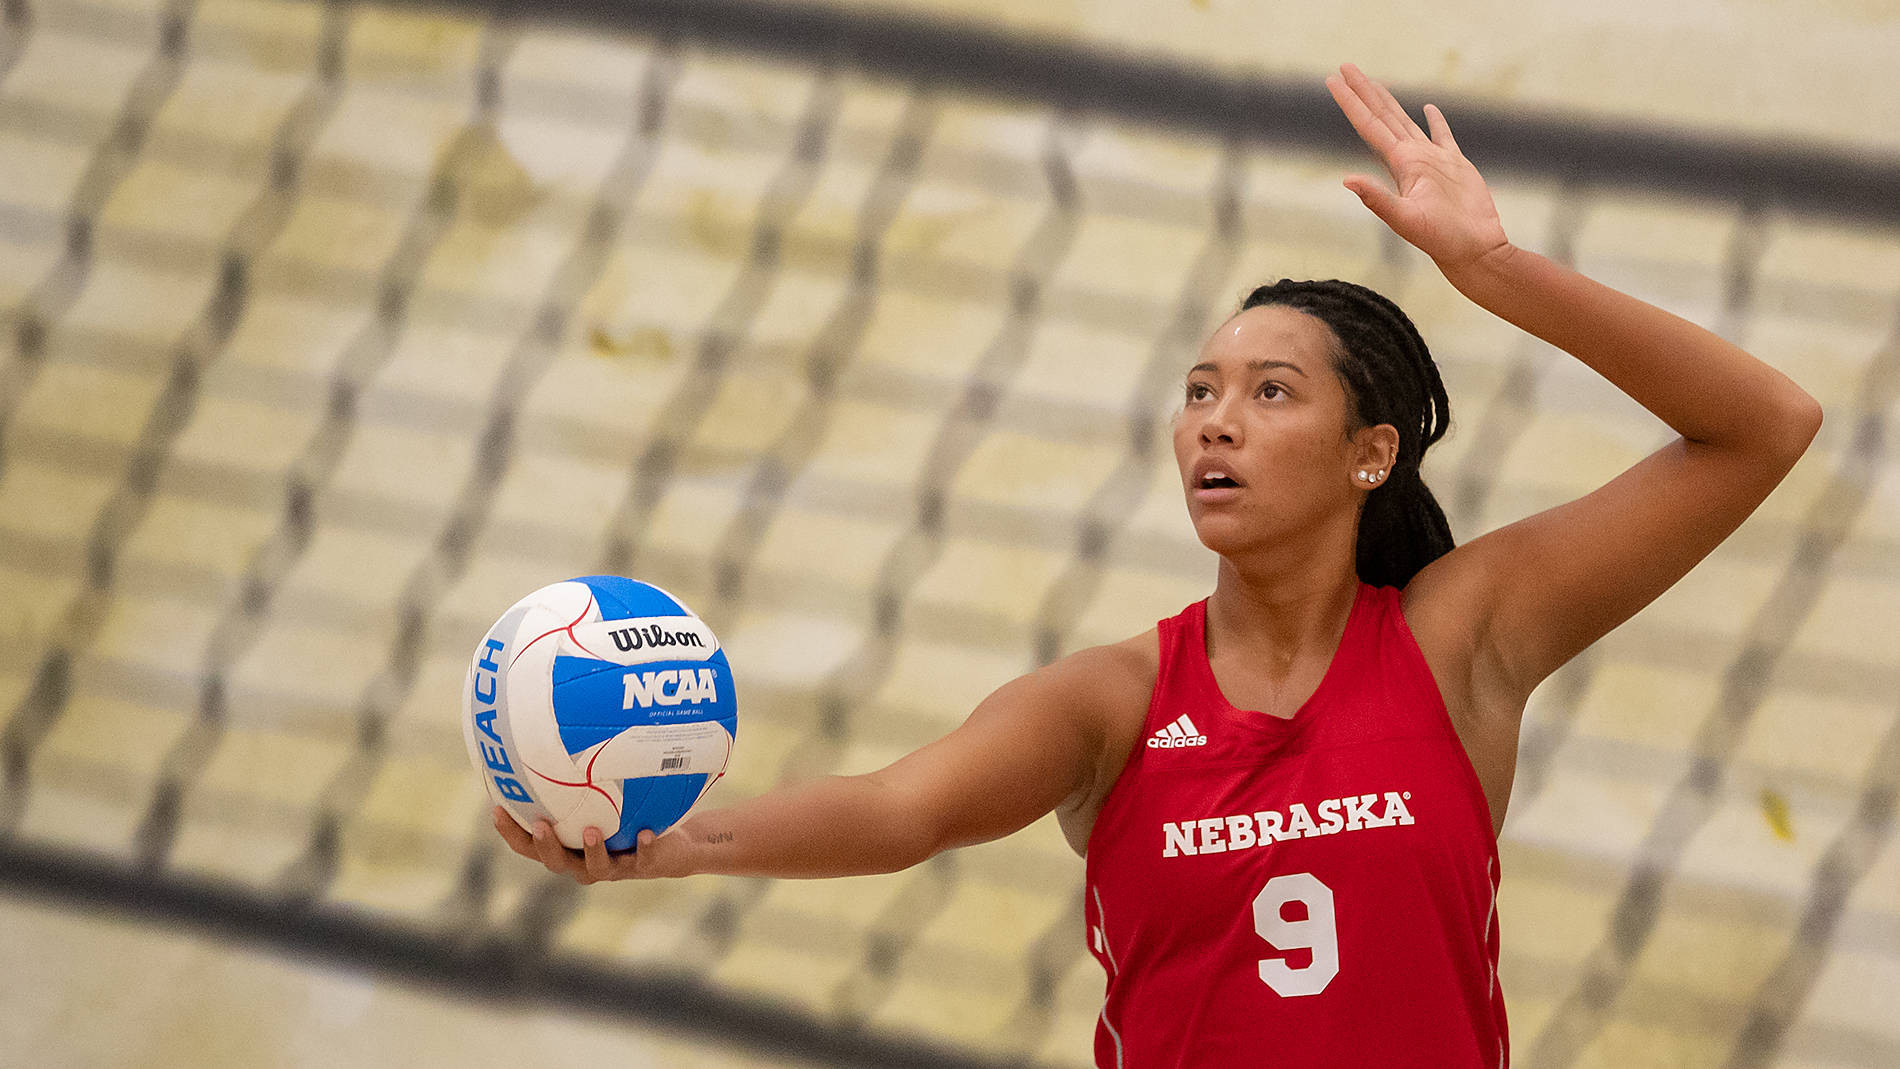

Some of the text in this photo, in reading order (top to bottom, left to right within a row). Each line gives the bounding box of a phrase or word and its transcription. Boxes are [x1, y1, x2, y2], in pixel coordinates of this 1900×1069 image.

[608, 625, 706, 652] Wilson
[475, 639, 534, 803] BEACH
[1147, 735, 1207, 748] adidas
[1162, 791, 1415, 858] NEBRASKA
[1252, 872, 1340, 998] 9
